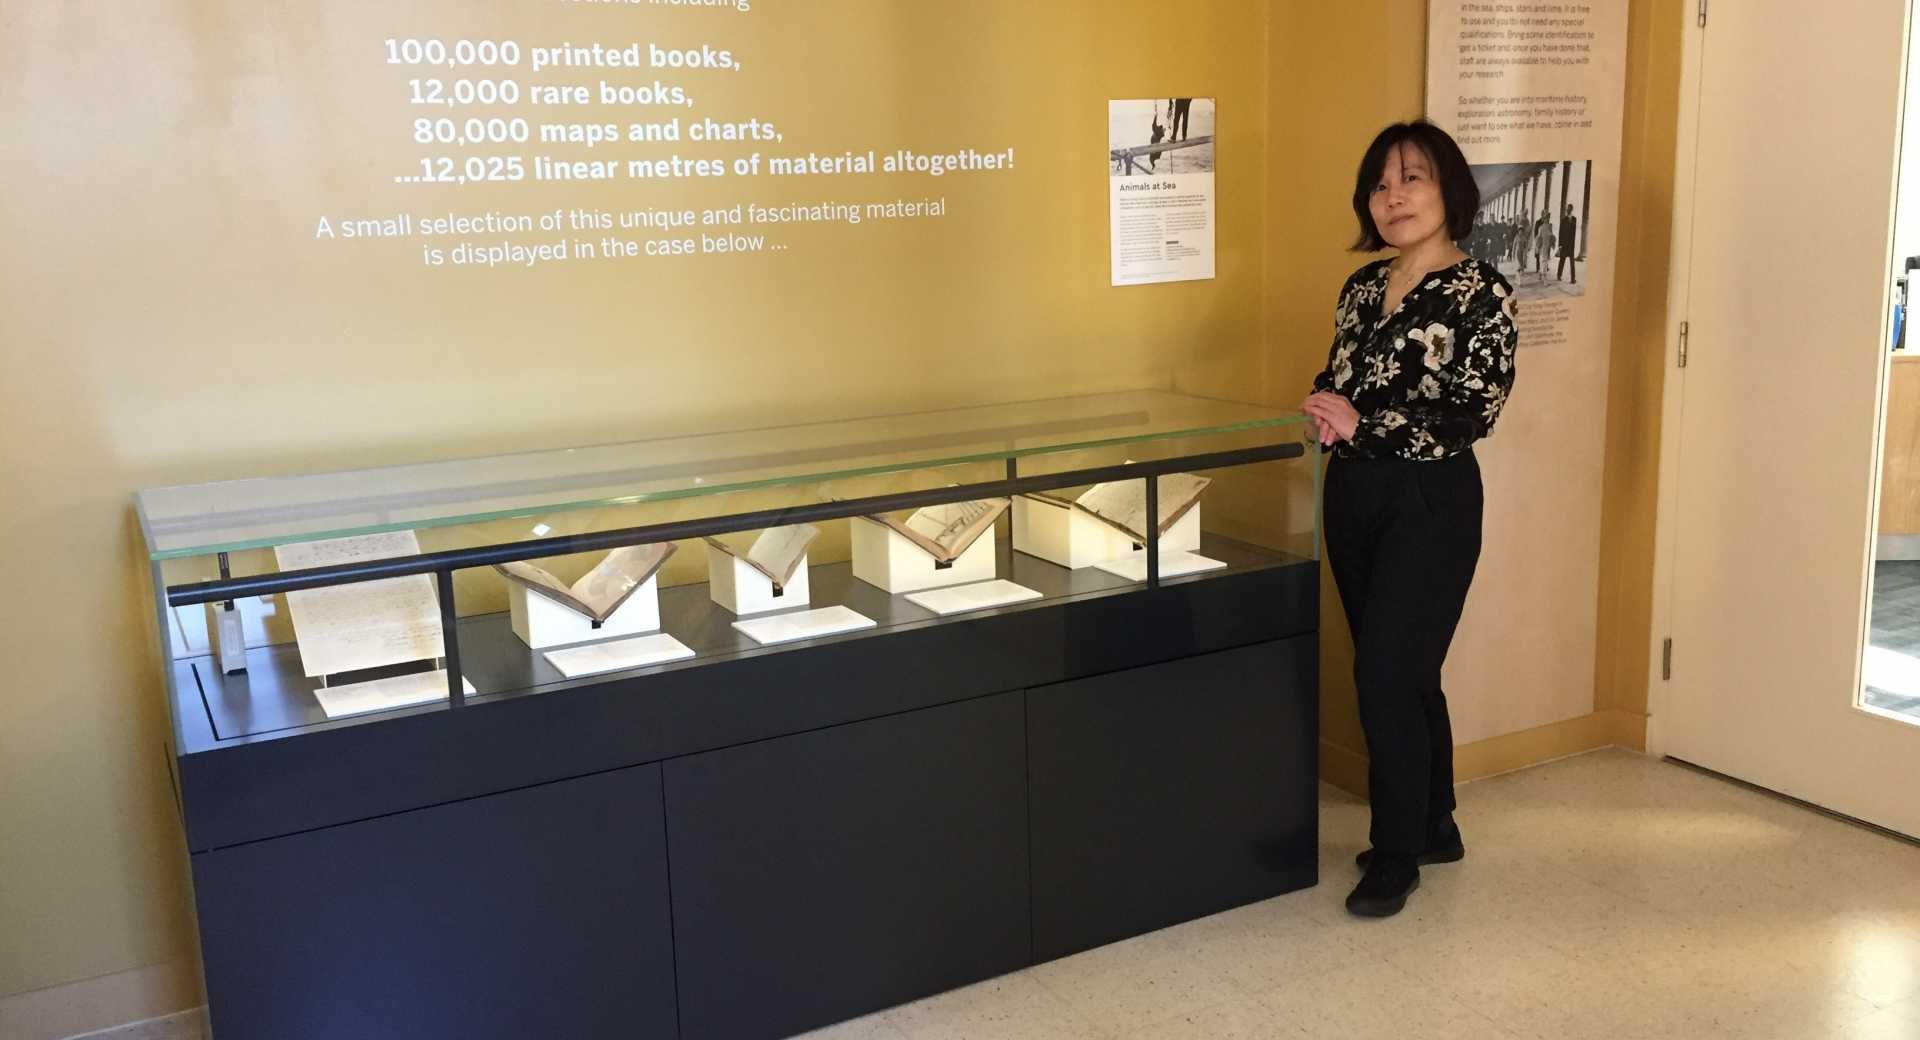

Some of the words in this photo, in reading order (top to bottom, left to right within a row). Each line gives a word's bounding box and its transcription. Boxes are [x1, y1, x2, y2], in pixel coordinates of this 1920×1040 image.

[384, 39, 520, 69] 100,000
[532, 42, 640, 72] printed
[649, 43, 741, 71] books,
[408, 79, 520, 108] 12,000
[530, 84, 590, 105] rare
[600, 81, 694, 108] books,
[413, 118, 529, 147] 80,000
[540, 122, 619, 148] maps
[628, 118, 680, 142] and
[689, 118, 783, 144] charts,
[534, 156, 618, 180] linear
[628, 154, 726, 179] metres
[734, 153, 760, 176] of
[769, 151, 875, 175] material
[883, 148, 1014, 176] altogether!
[1120, 182, 1150, 192] Animals
[1162, 181, 1176, 190] Sea
[316, 216, 336, 238] A
[341, 214, 412, 238] small
[420, 212, 534, 234] selection
[540, 209, 562, 231] of
[569, 209, 614, 230] this
[620, 207, 696, 231] unique
[702, 204, 742, 225] and
[748, 201, 860, 224] fascinating
[866, 197, 945, 218] material
[424, 244, 444, 266] is
[452, 240, 567, 267] displayed
[574, 238, 595, 258] in
[602, 237, 638, 257] the
[645, 239, 696, 256] case
[702, 234, 764, 253] below
